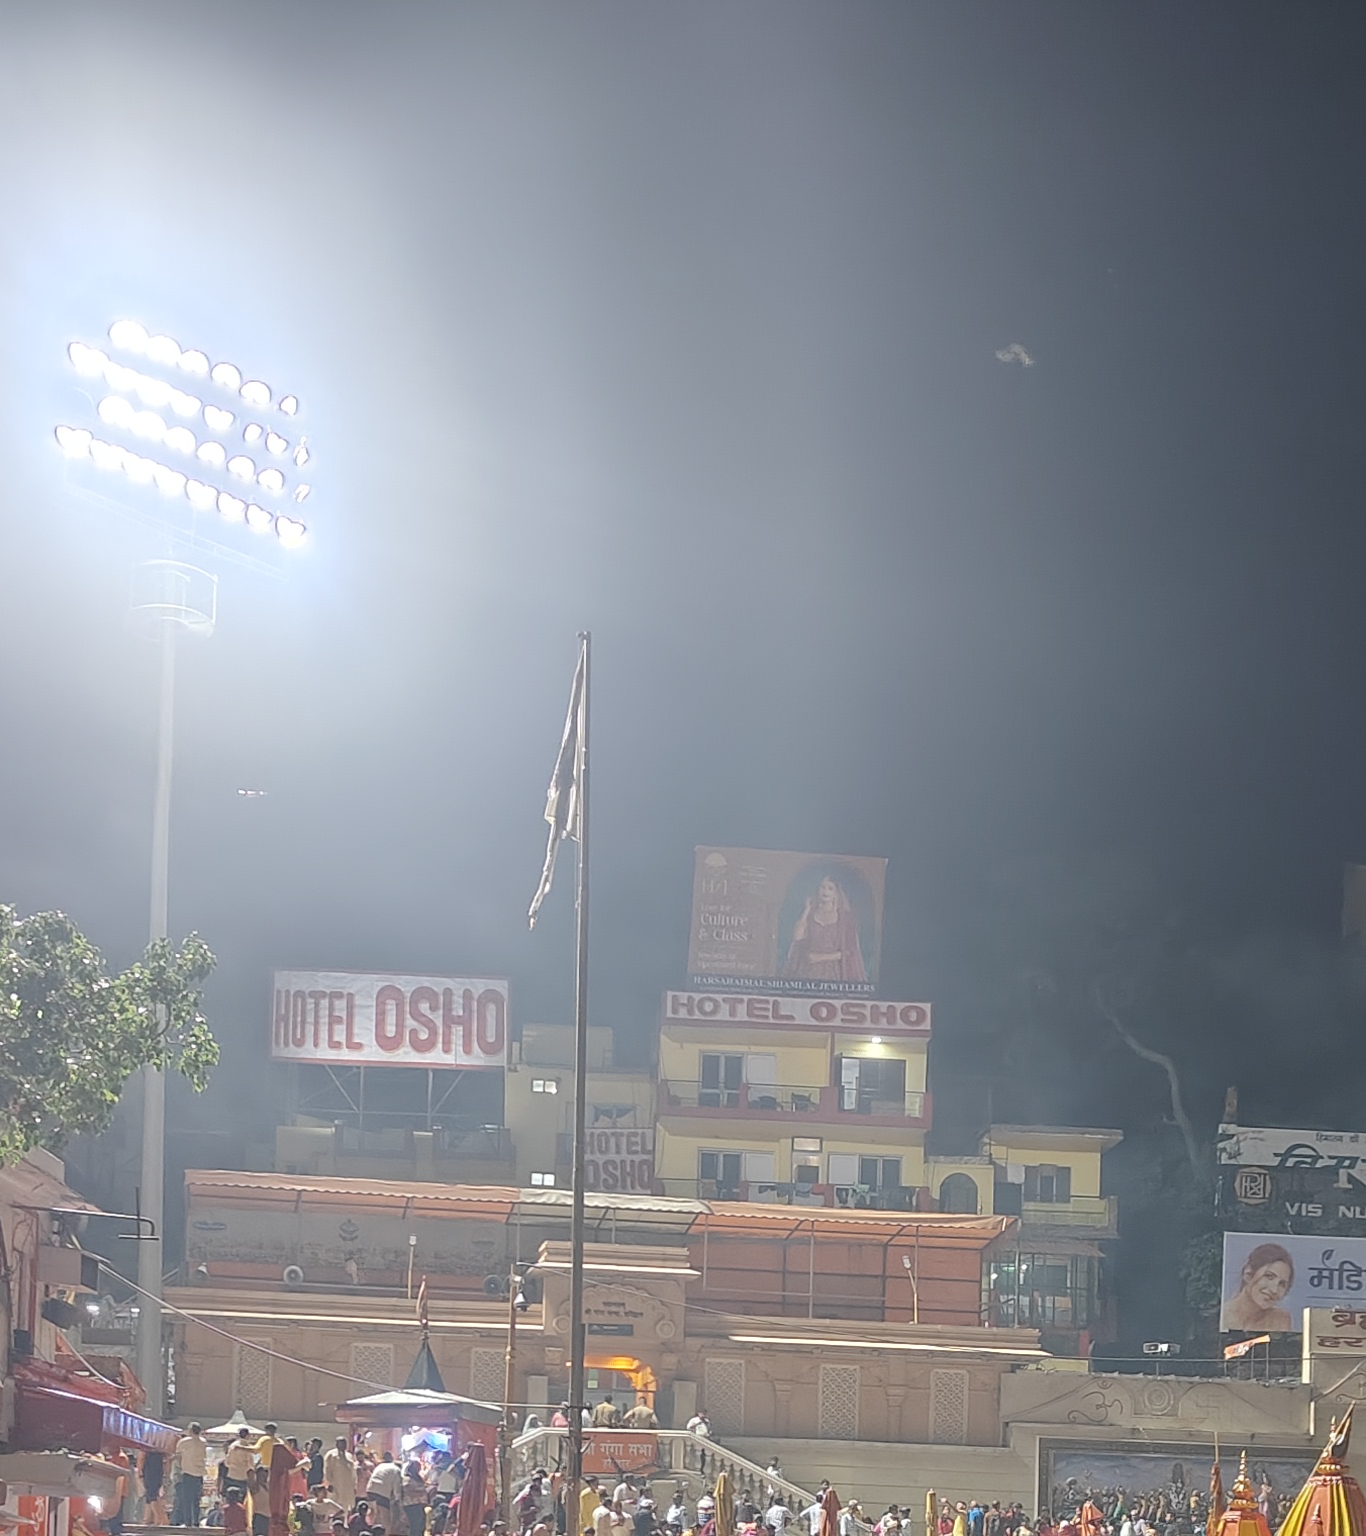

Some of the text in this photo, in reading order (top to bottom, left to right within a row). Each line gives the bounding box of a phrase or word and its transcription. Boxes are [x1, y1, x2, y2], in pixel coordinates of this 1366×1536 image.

[700, 912, 749, 927] Culture
[698, 928, 749, 942] & Class
[819, 982, 876, 994] JEWELLERS
[275, 984, 505, 1056] HOTEL OSHO
[670, 994, 928, 1027] HOTEL OSHO
[584, 1130, 653, 1156] HOTEL
[584, 1158, 653, 1192] OSHO
[628, 1443, 653, 1457] सभा
